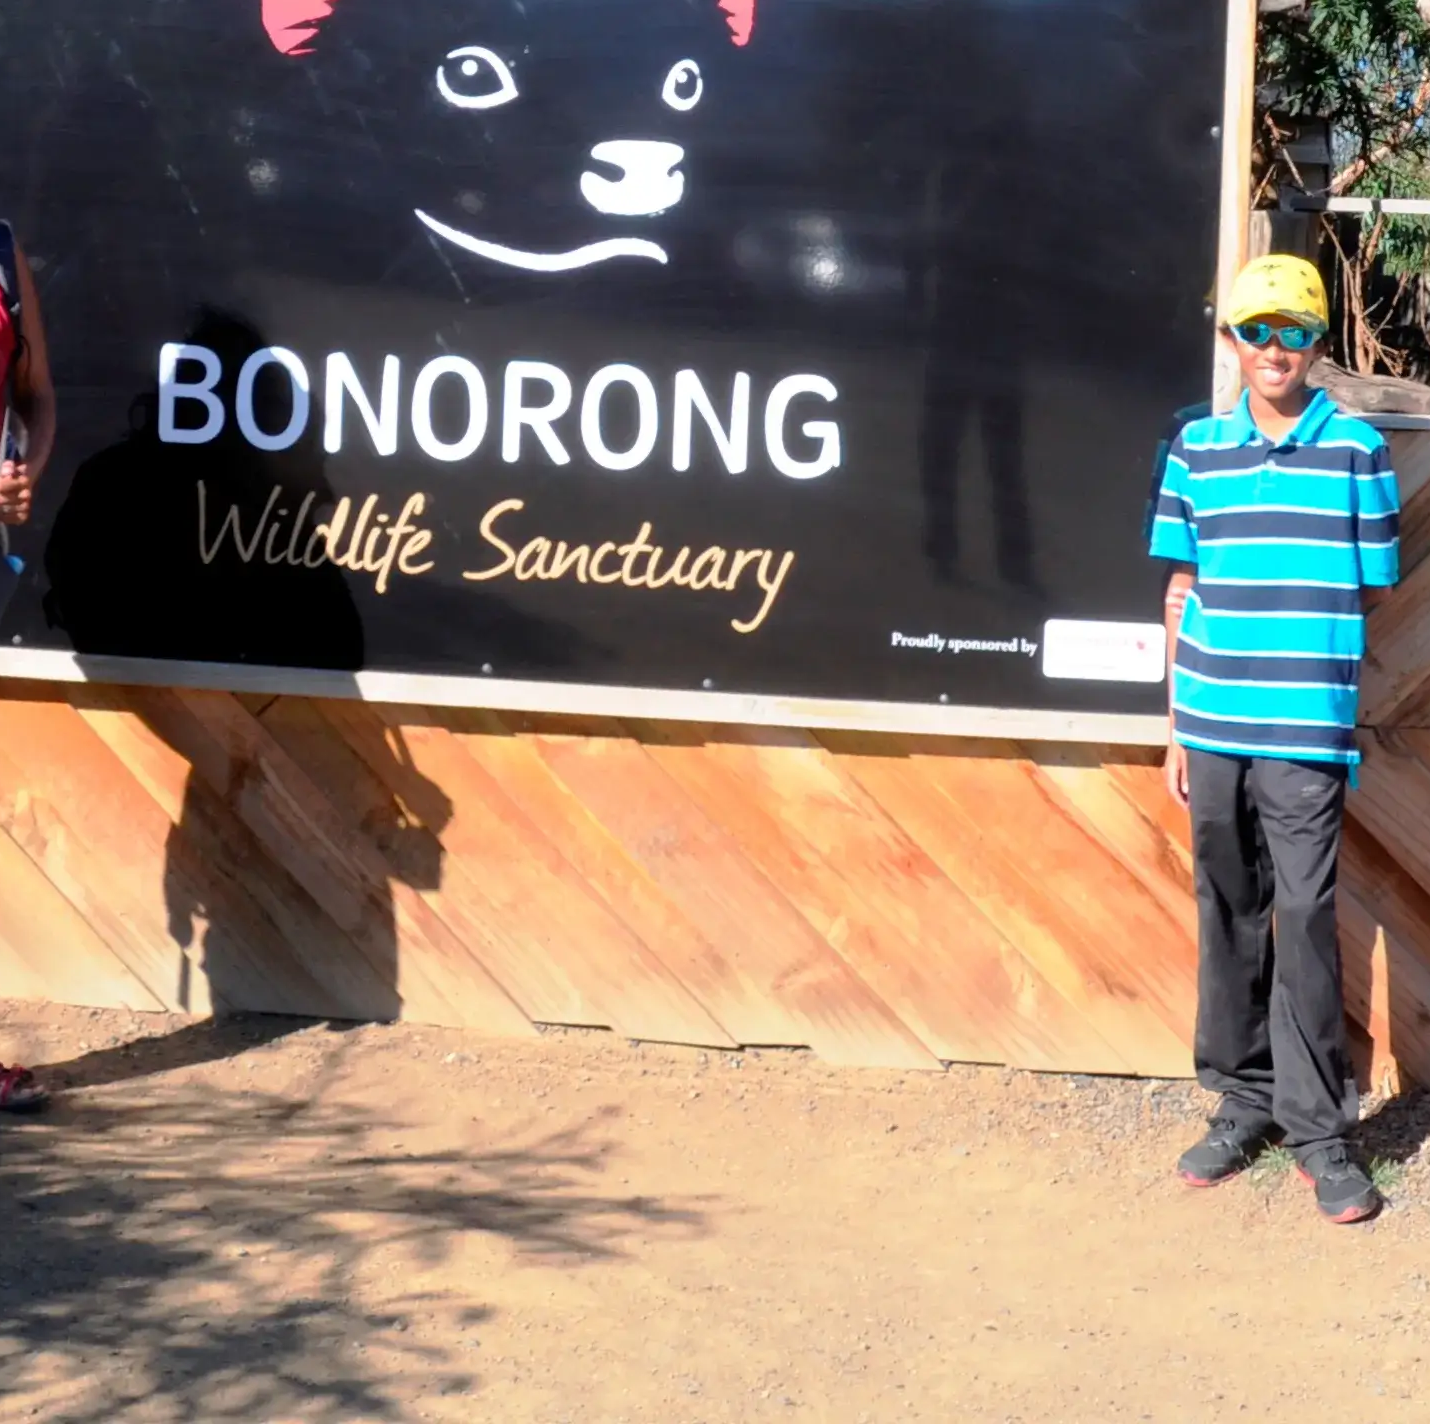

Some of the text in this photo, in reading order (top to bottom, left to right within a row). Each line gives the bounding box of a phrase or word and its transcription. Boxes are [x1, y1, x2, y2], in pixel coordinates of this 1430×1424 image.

[158, 342, 842, 481] BONORONG
[197, 480, 795, 634] Wildlife Sanctuary
[891, 631, 946, 653] Proudly
[947, 637, 1018, 654] sponsored
[1020, 637, 1038, 658] by
